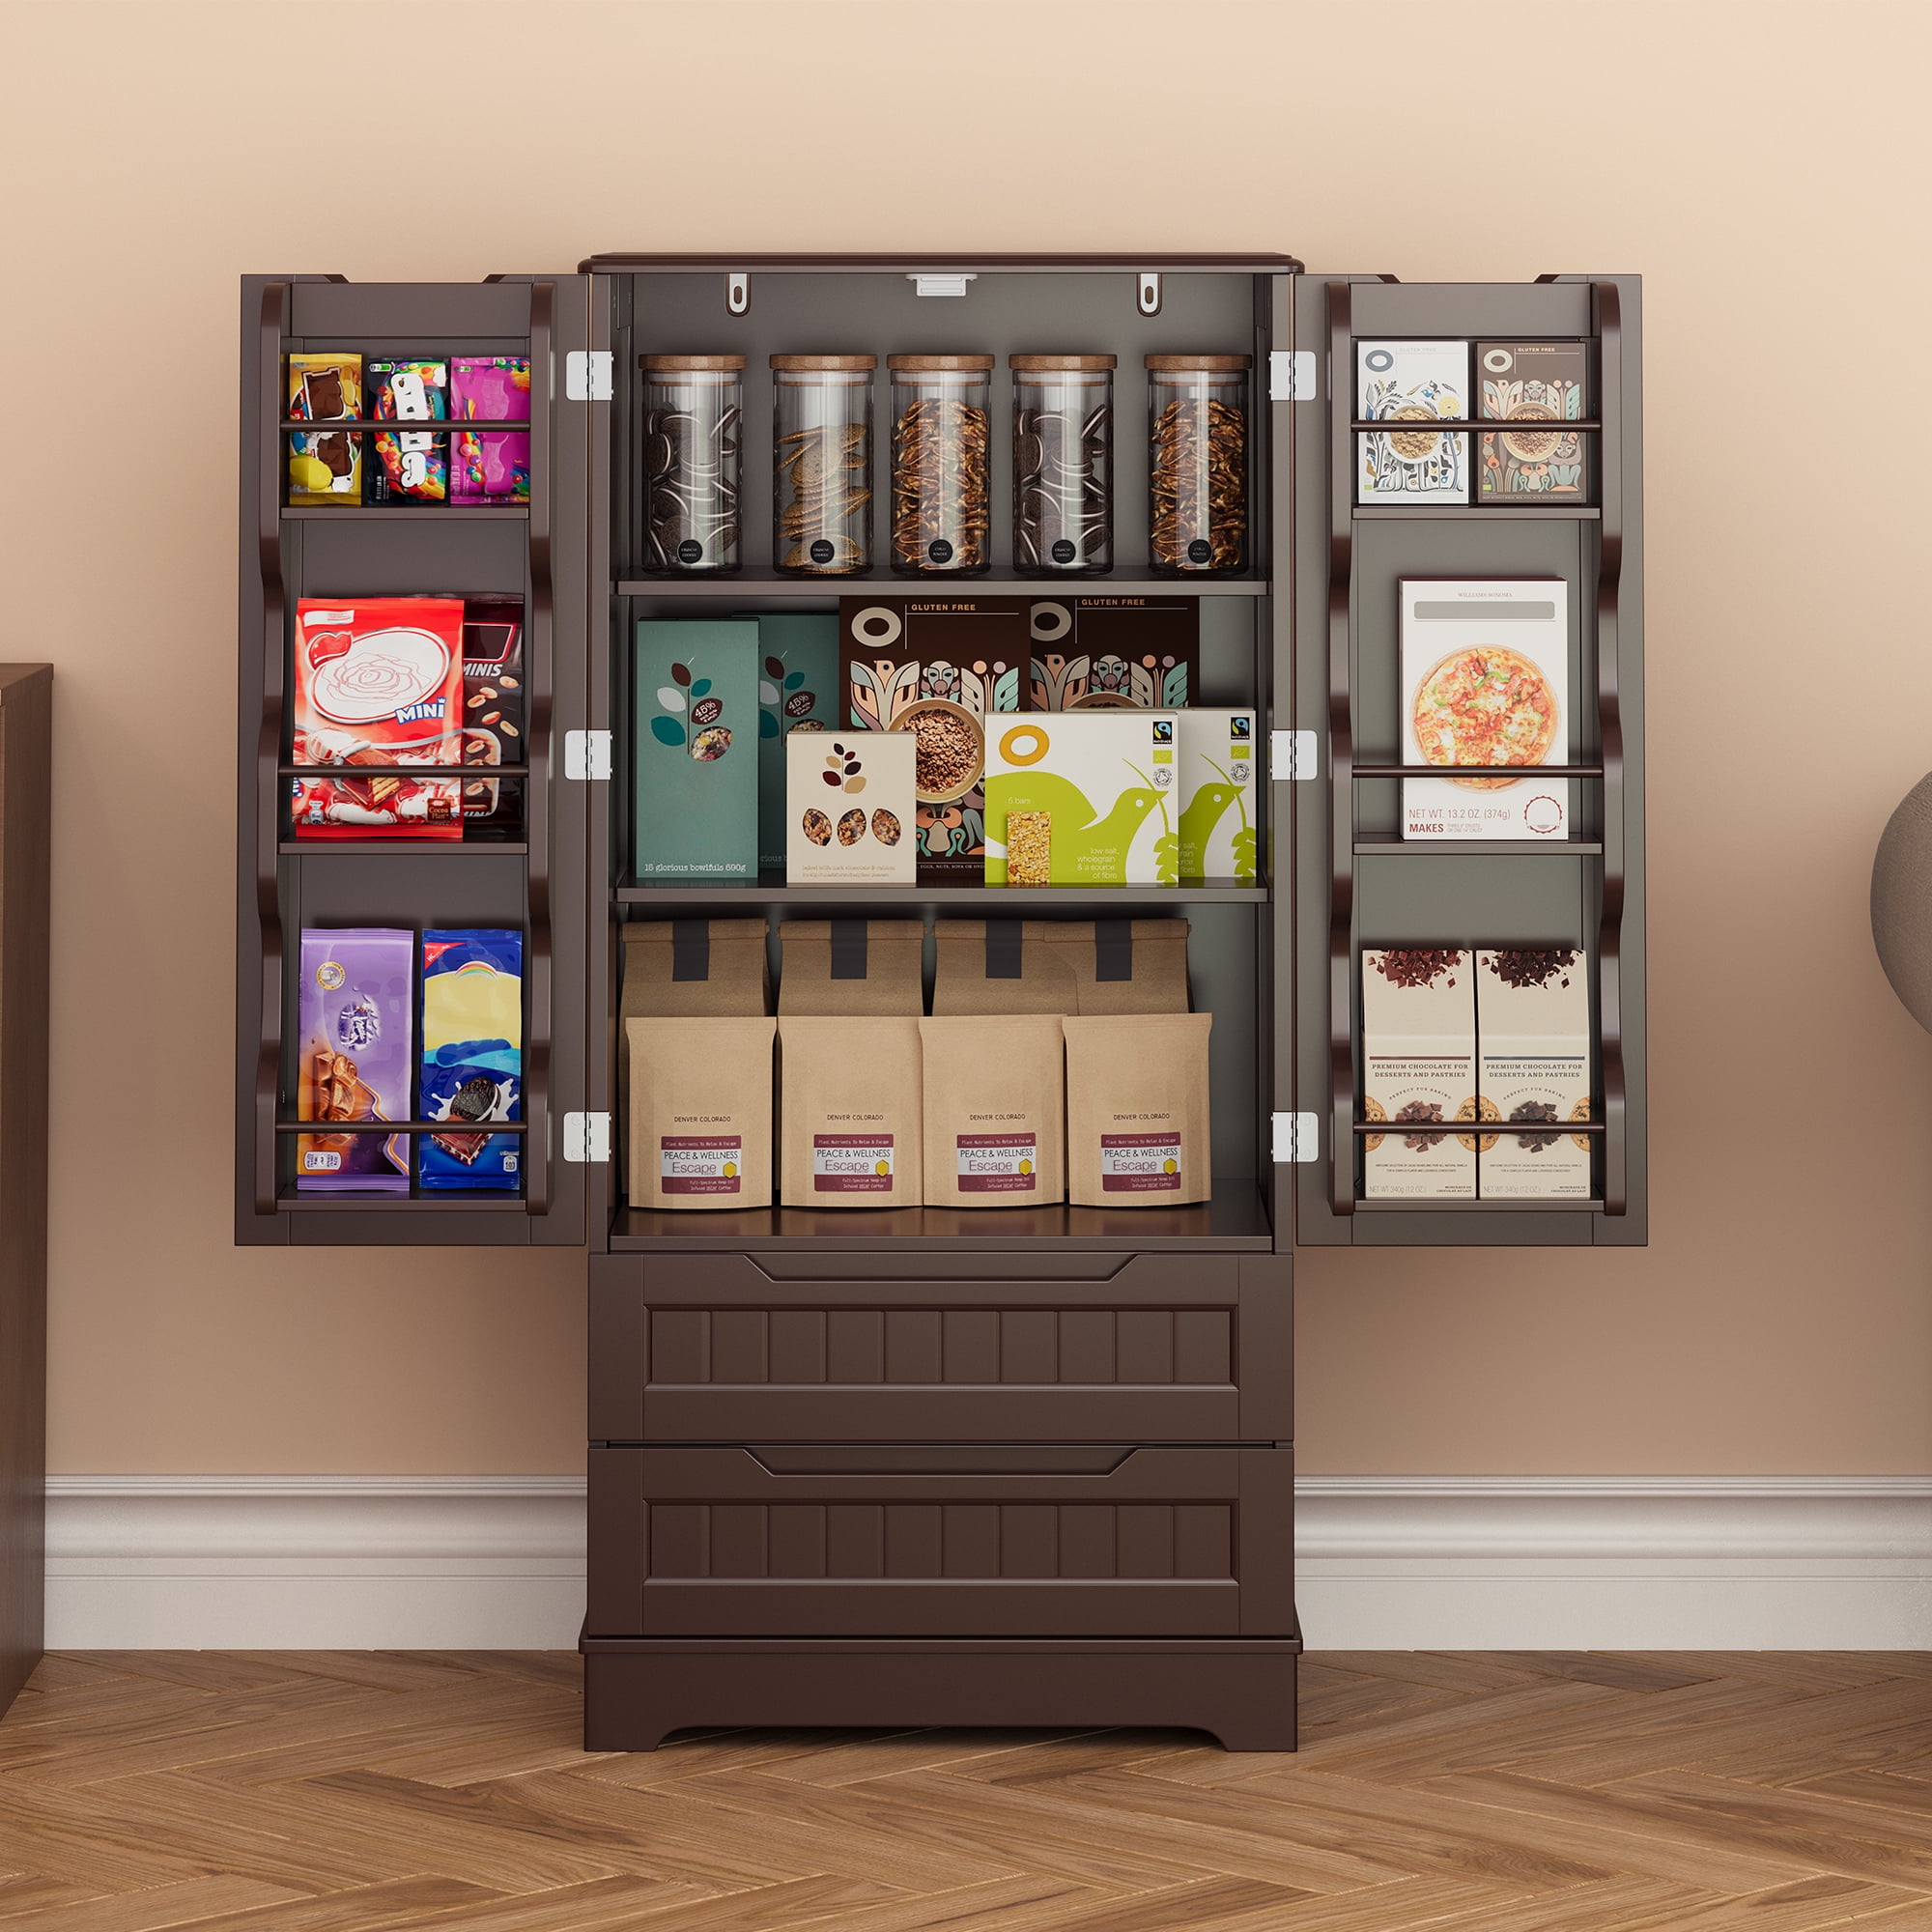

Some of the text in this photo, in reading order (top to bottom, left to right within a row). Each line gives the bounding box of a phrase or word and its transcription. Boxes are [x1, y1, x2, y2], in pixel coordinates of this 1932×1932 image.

[396, 697, 445, 724] MINI
[1408, 810, 1426, 819] NET
[1428, 810, 1444, 819] WT.
[1448, 810, 1465, 819] 13.2
[1484, 809, 1511, 821] (374g)
[1408, 823, 1444, 833] MAKES
[655, 863, 689, 872] glorious
[700, 1151, 738, 1159] WELLNESS
[853, 1149, 891, 1157] WELLNESS
[997, 1148, 1033, 1157] WELLNESS
[1141, 1148, 1178, 1157] WELLNESS
[672, 1161, 717, 1175] Escape
[825, 1160, 869, 1173] Escape
[969, 1160, 1012, 1173] Escape
[1113, 1159, 1157, 1173] Escape
